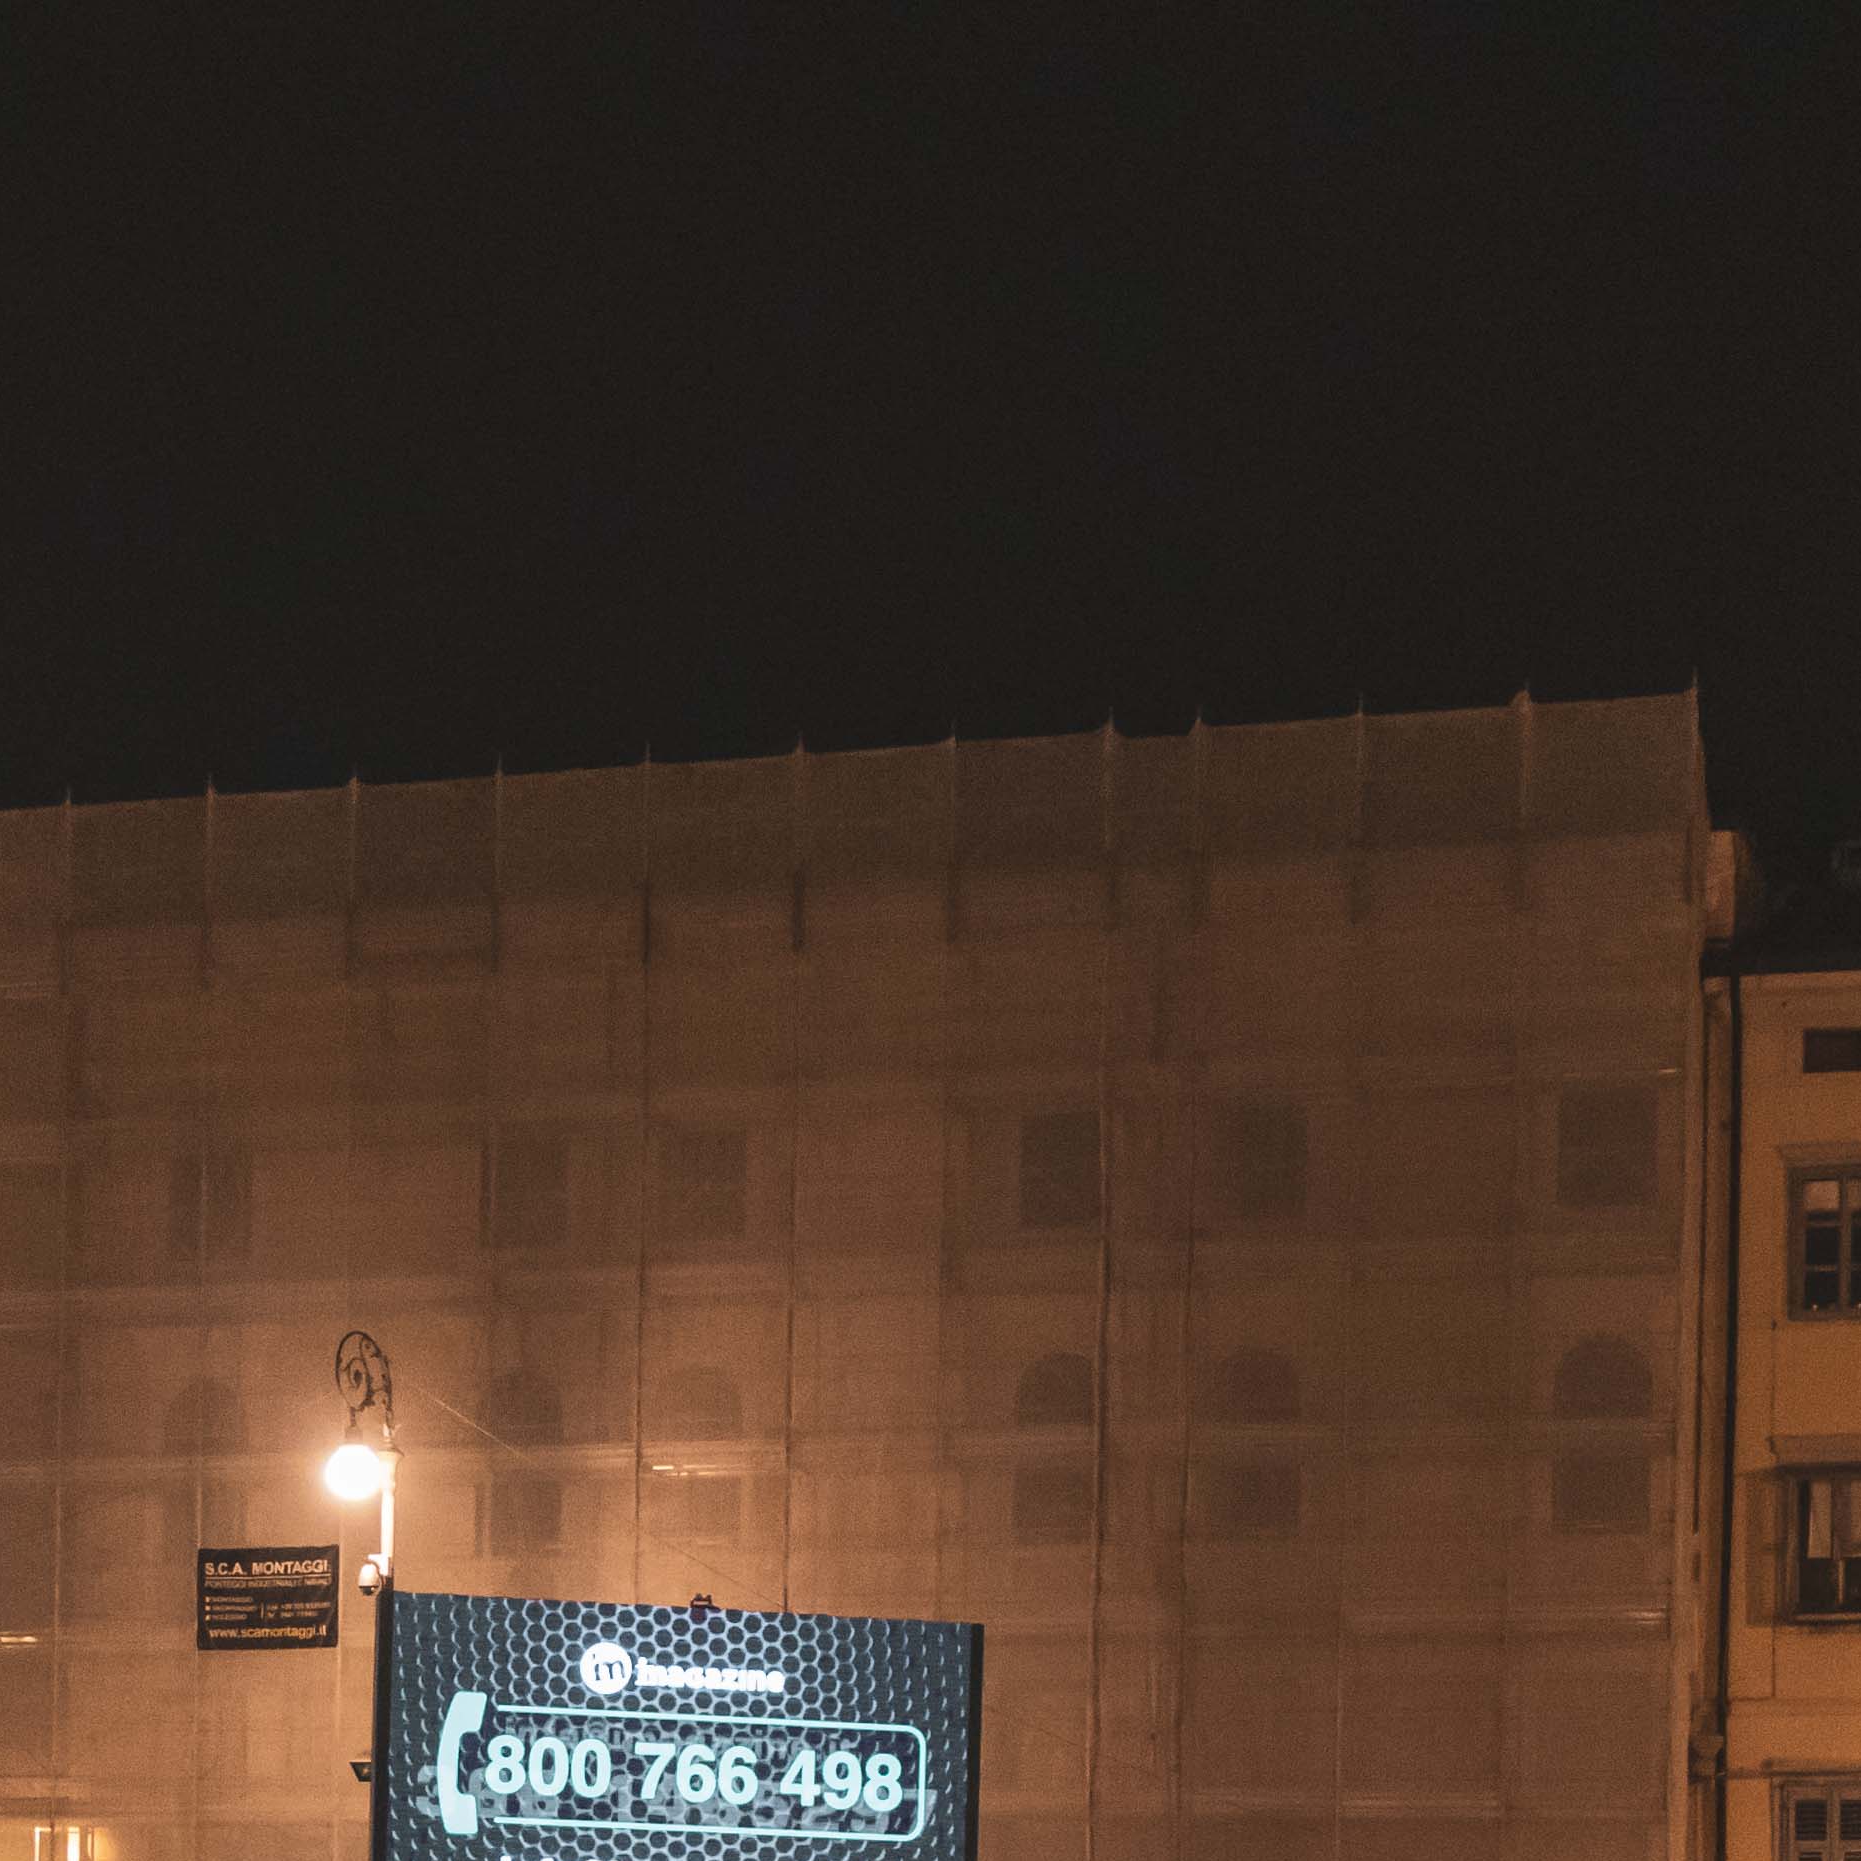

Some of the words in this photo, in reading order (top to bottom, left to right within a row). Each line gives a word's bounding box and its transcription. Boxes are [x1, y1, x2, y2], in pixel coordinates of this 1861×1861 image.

[204, 1562, 247, 1576] S.C.A.
[208, 1624, 327, 1640] www.scamontaggi.it
[484, 1734, 612, 1798] 800
[634, 1741, 758, 1805] 766
[779, 1749, 903, 1812] 498
